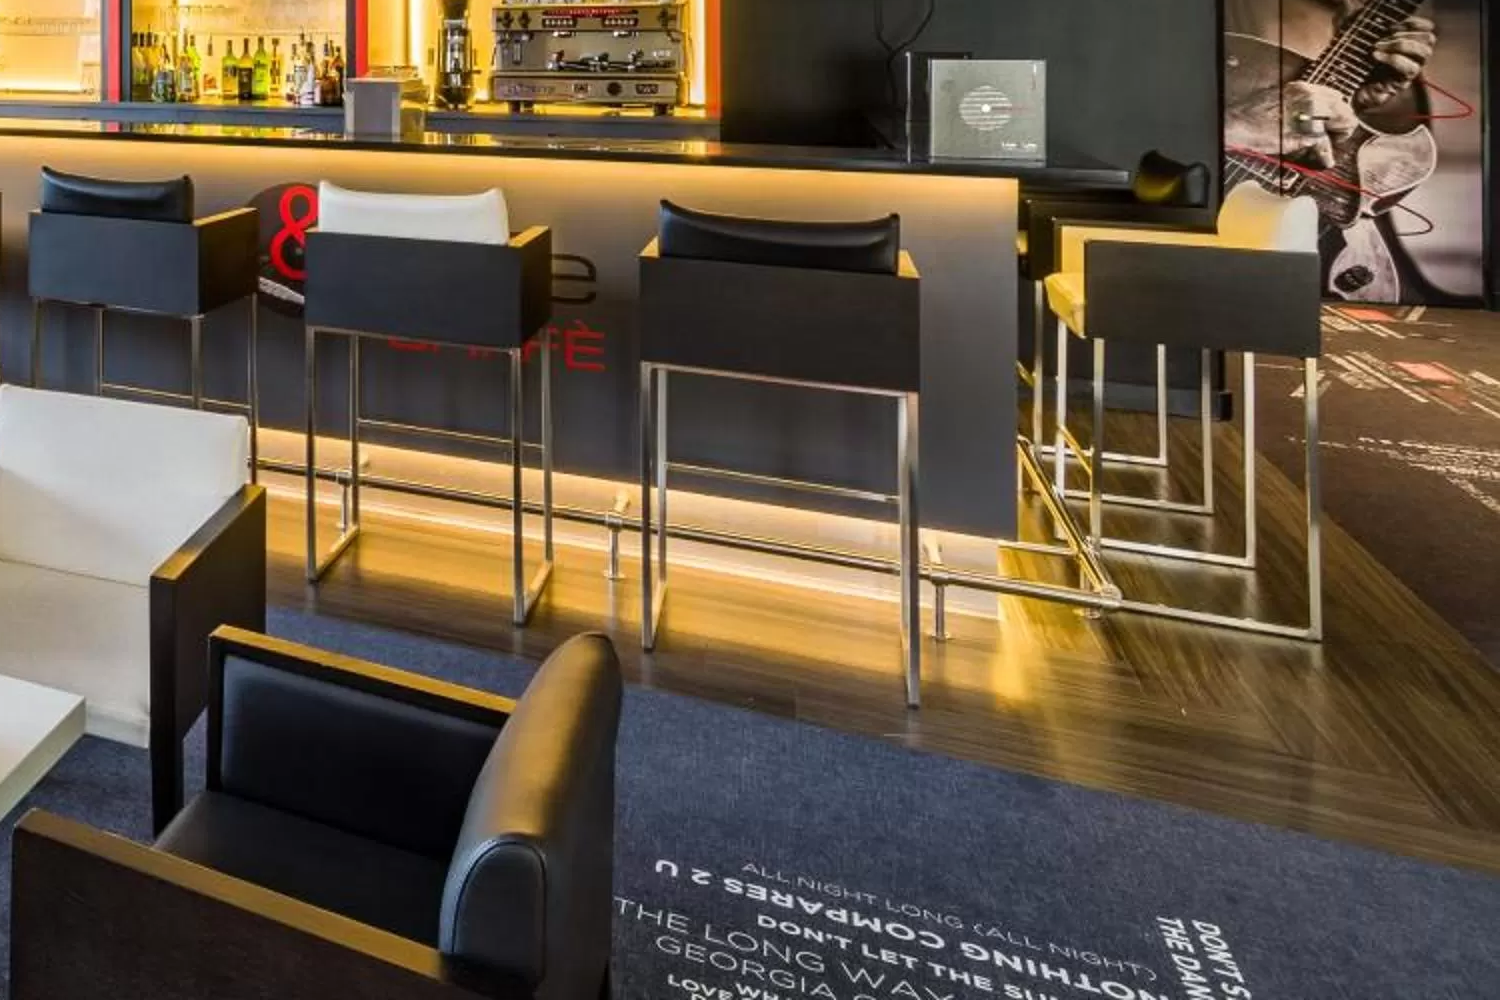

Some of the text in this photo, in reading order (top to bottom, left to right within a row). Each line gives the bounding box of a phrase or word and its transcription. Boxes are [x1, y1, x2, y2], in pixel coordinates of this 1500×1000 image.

[655, 859, 678, 877] U
[691, 868, 712, 885] 2
[613, 896, 691, 935] THE
[704, 924, 825, 973] LONG
[723, 878, 945, 949] COMPARES
[742, 863, 790, 884] ALL
[798, 876, 877, 905] NIGHT
[885, 899, 963, 929] LONG
[973, 923, 1042, 950] (ALL
[656, 936, 836, 1000] GEORGIA
[757, 914, 852, 950] DON'T
[861, 944, 918, 969] LET
[927, 961, 993, 991] THE
[1156, 916, 1216, 1000] THE DAN
[1192, 919, 1244, 983] DON'T
